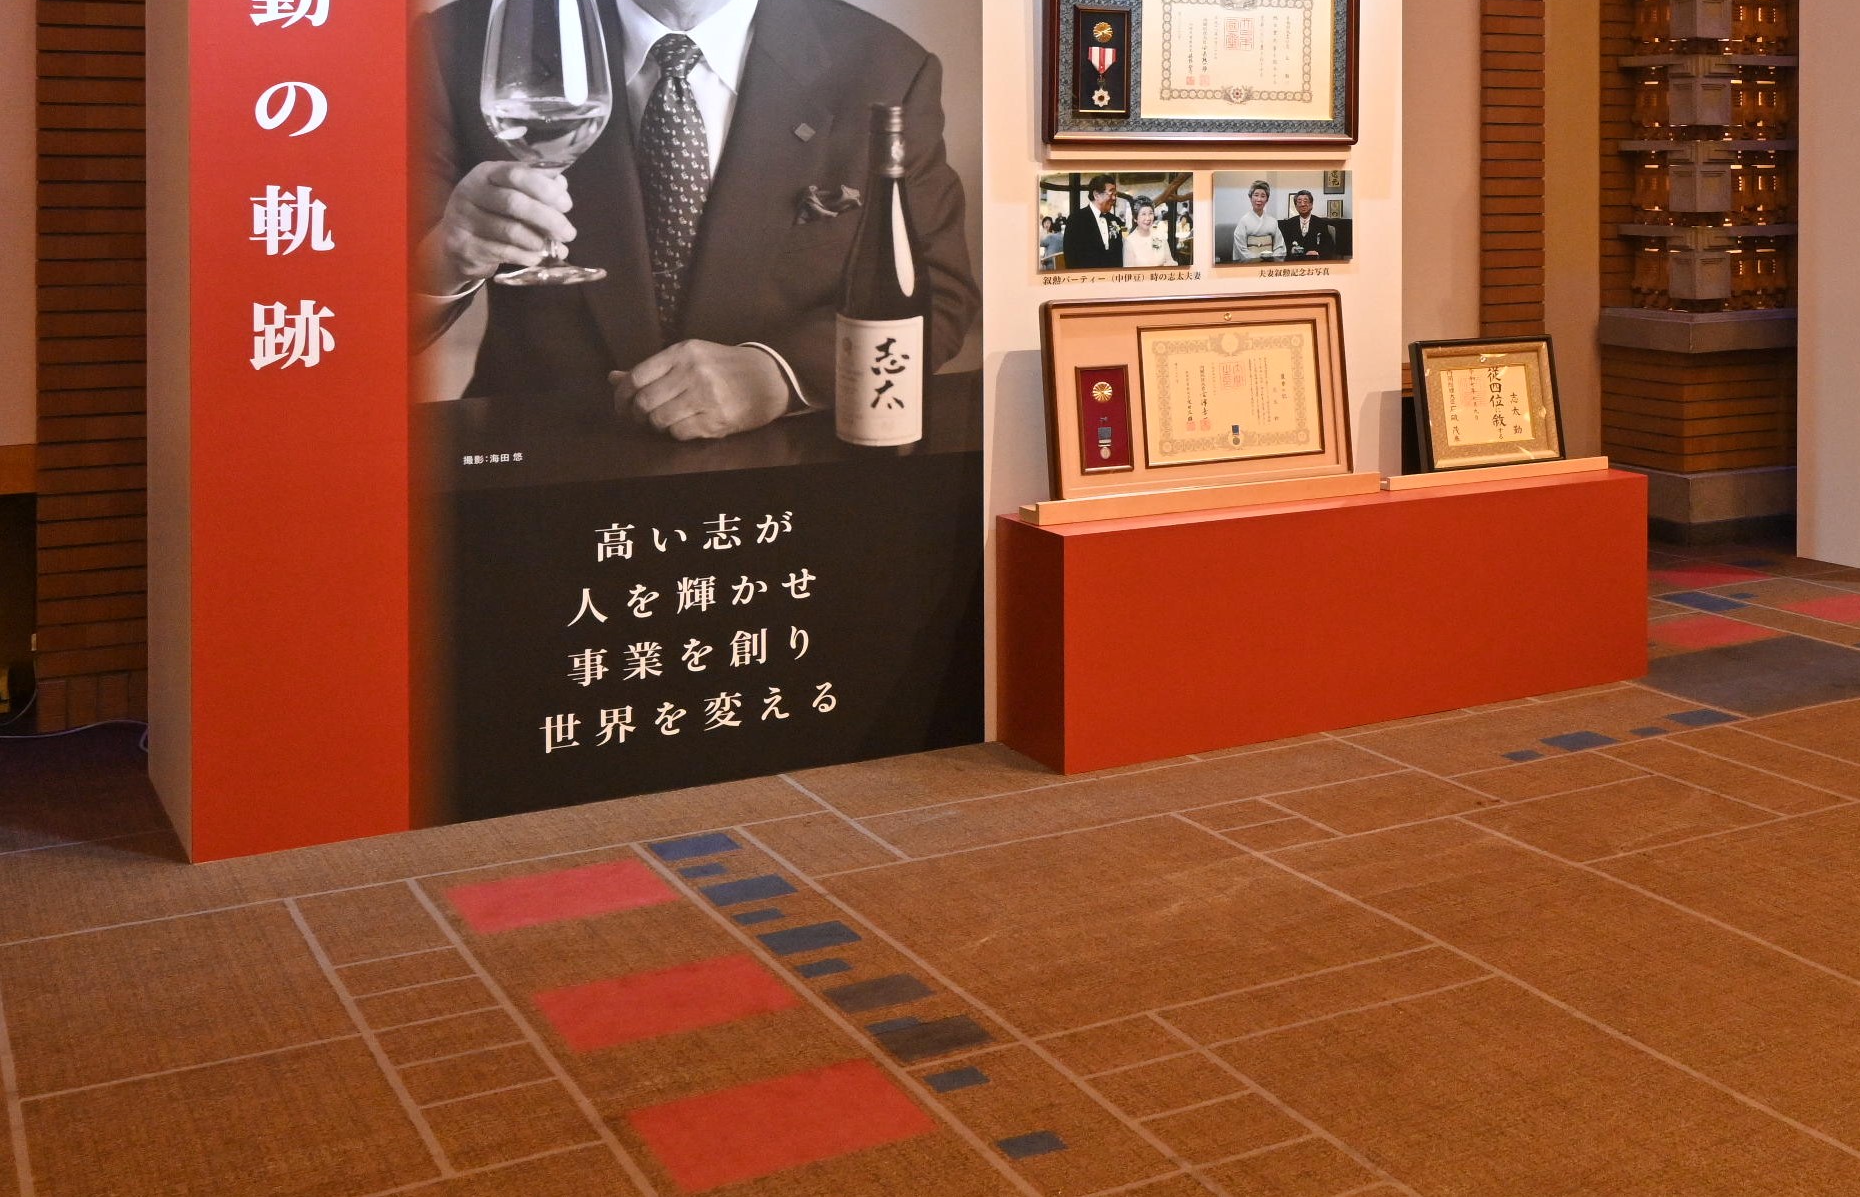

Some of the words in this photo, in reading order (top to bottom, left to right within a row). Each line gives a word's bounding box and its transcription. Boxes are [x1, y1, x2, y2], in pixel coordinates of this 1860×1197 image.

[595, 511, 793, 562] 高い志が
[567, 568, 816, 627] 人を輝かせ
[567, 626, 809, 687] 事業を創り
[539, 682, 837, 754] 世界を変える
